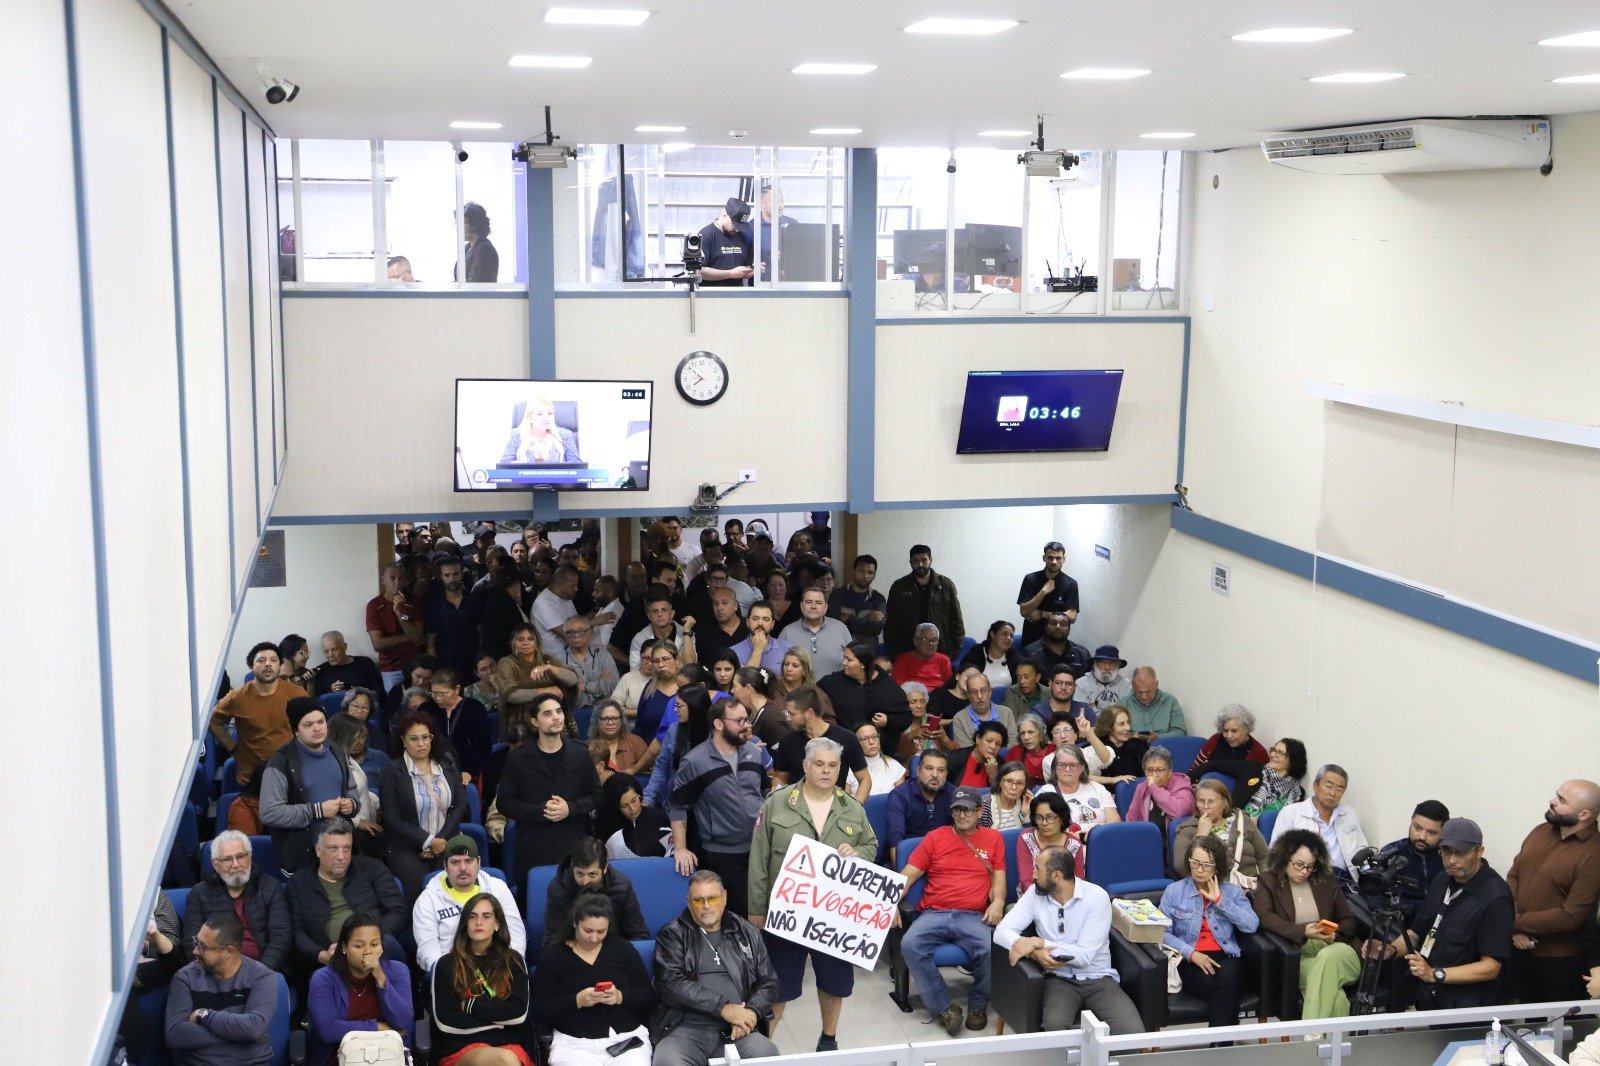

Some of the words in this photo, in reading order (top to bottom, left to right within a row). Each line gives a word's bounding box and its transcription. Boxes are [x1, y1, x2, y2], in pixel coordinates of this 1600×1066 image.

[1029, 406, 1081, 419] 03:46
[776, 877, 891, 929] REVOGAÇÃO
[822, 853, 904, 904] QUEREMOS
[767, 909, 796, 931] NÃO
[802, 916, 878, 959] ISENÇÃO
